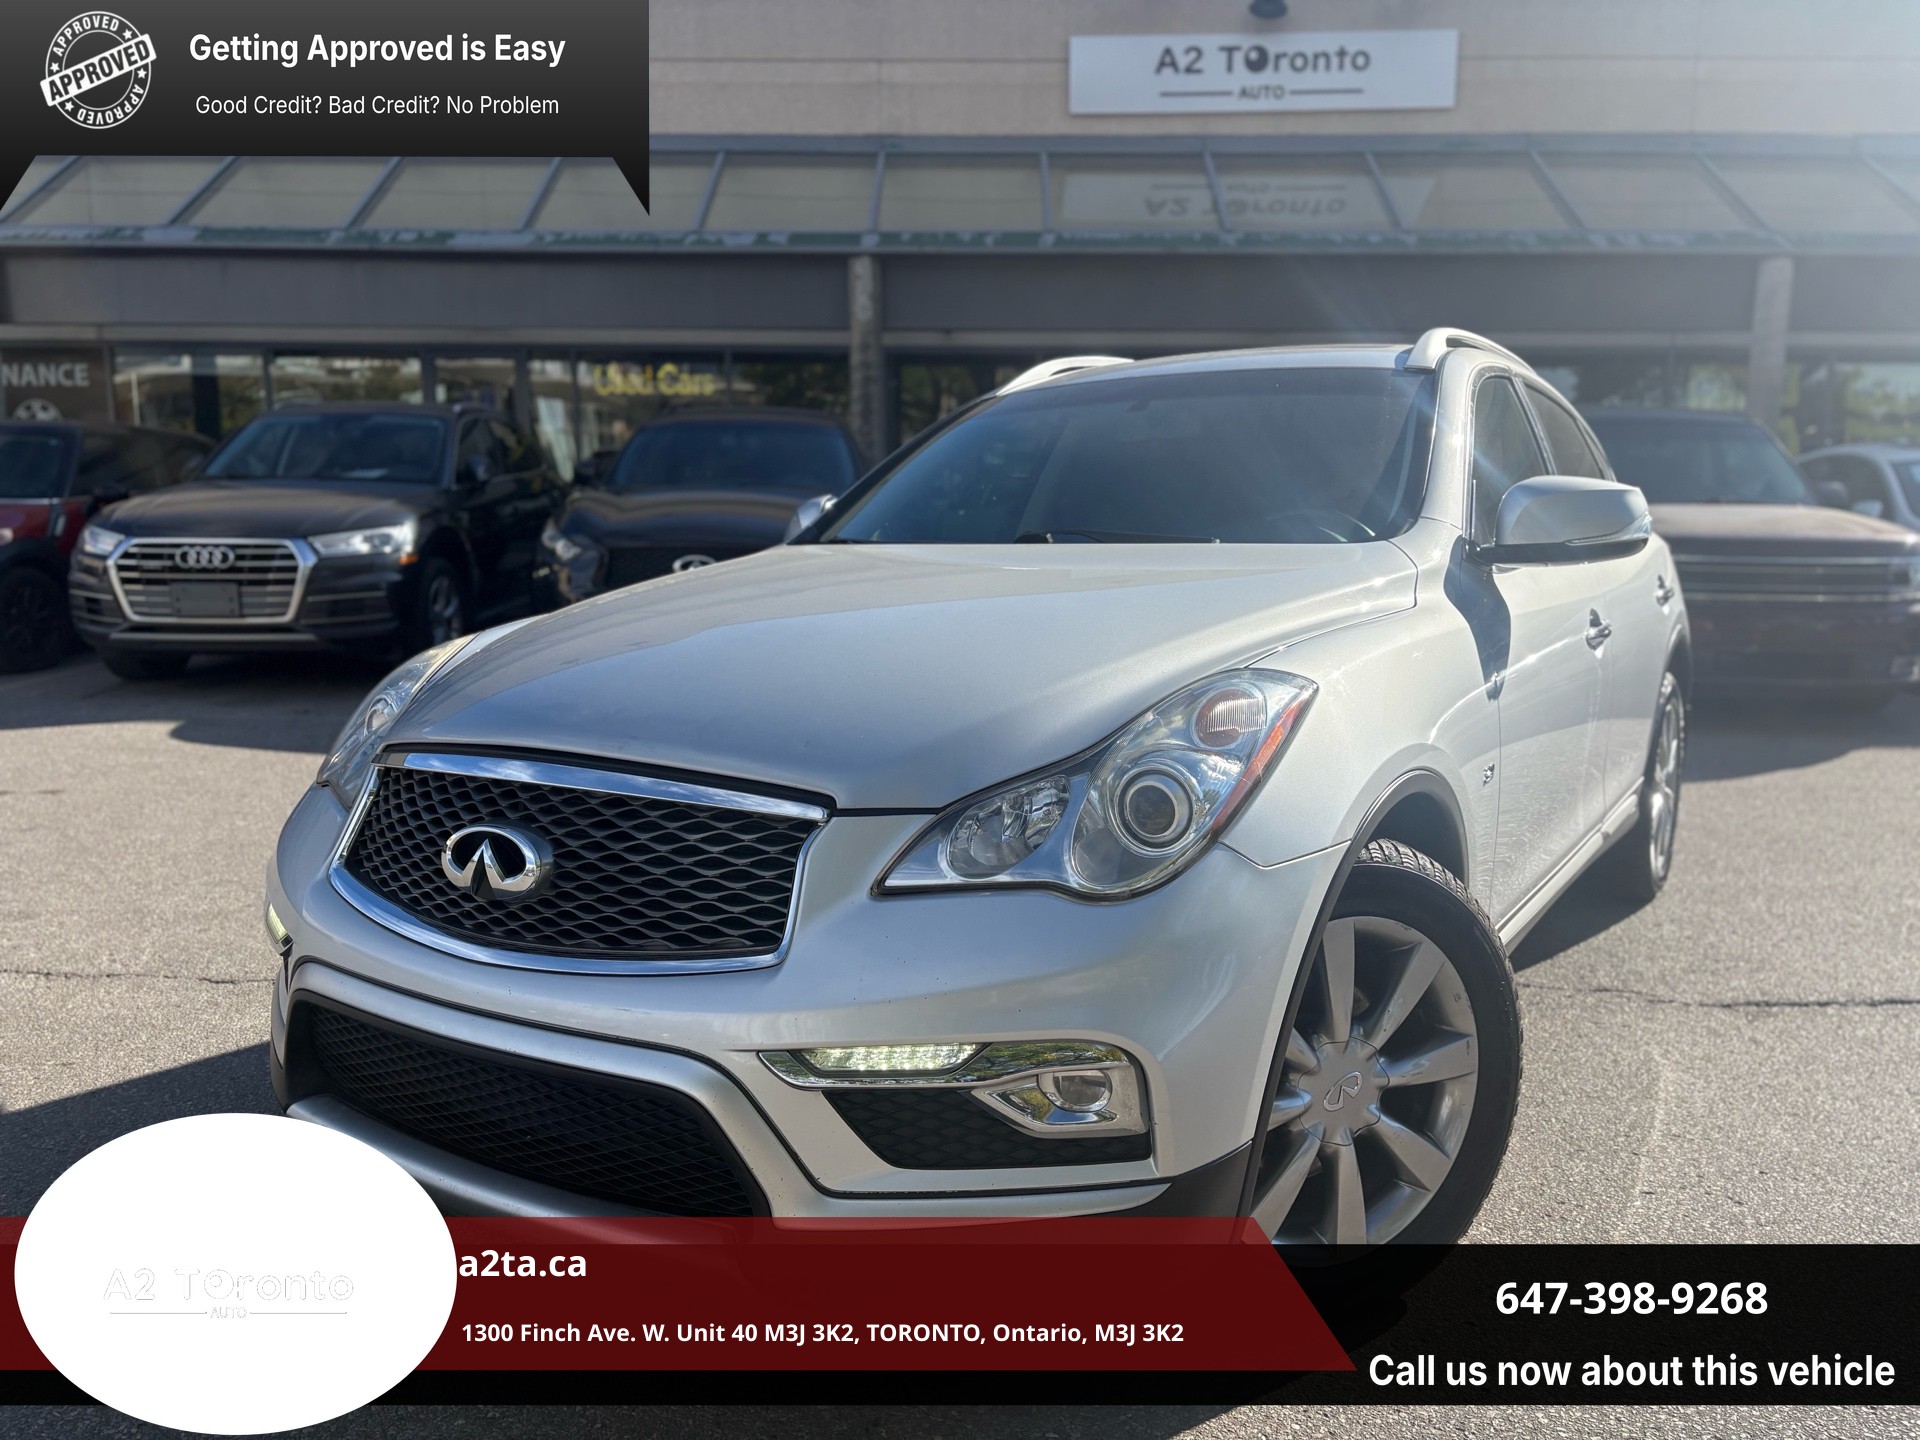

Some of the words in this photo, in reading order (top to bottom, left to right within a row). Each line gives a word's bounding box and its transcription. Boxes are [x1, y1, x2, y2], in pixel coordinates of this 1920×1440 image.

[1154, 46, 1204, 75] A2
[1237, 84, 1286, 100] AUTO
[0, 362, 90, 388] NANCE
